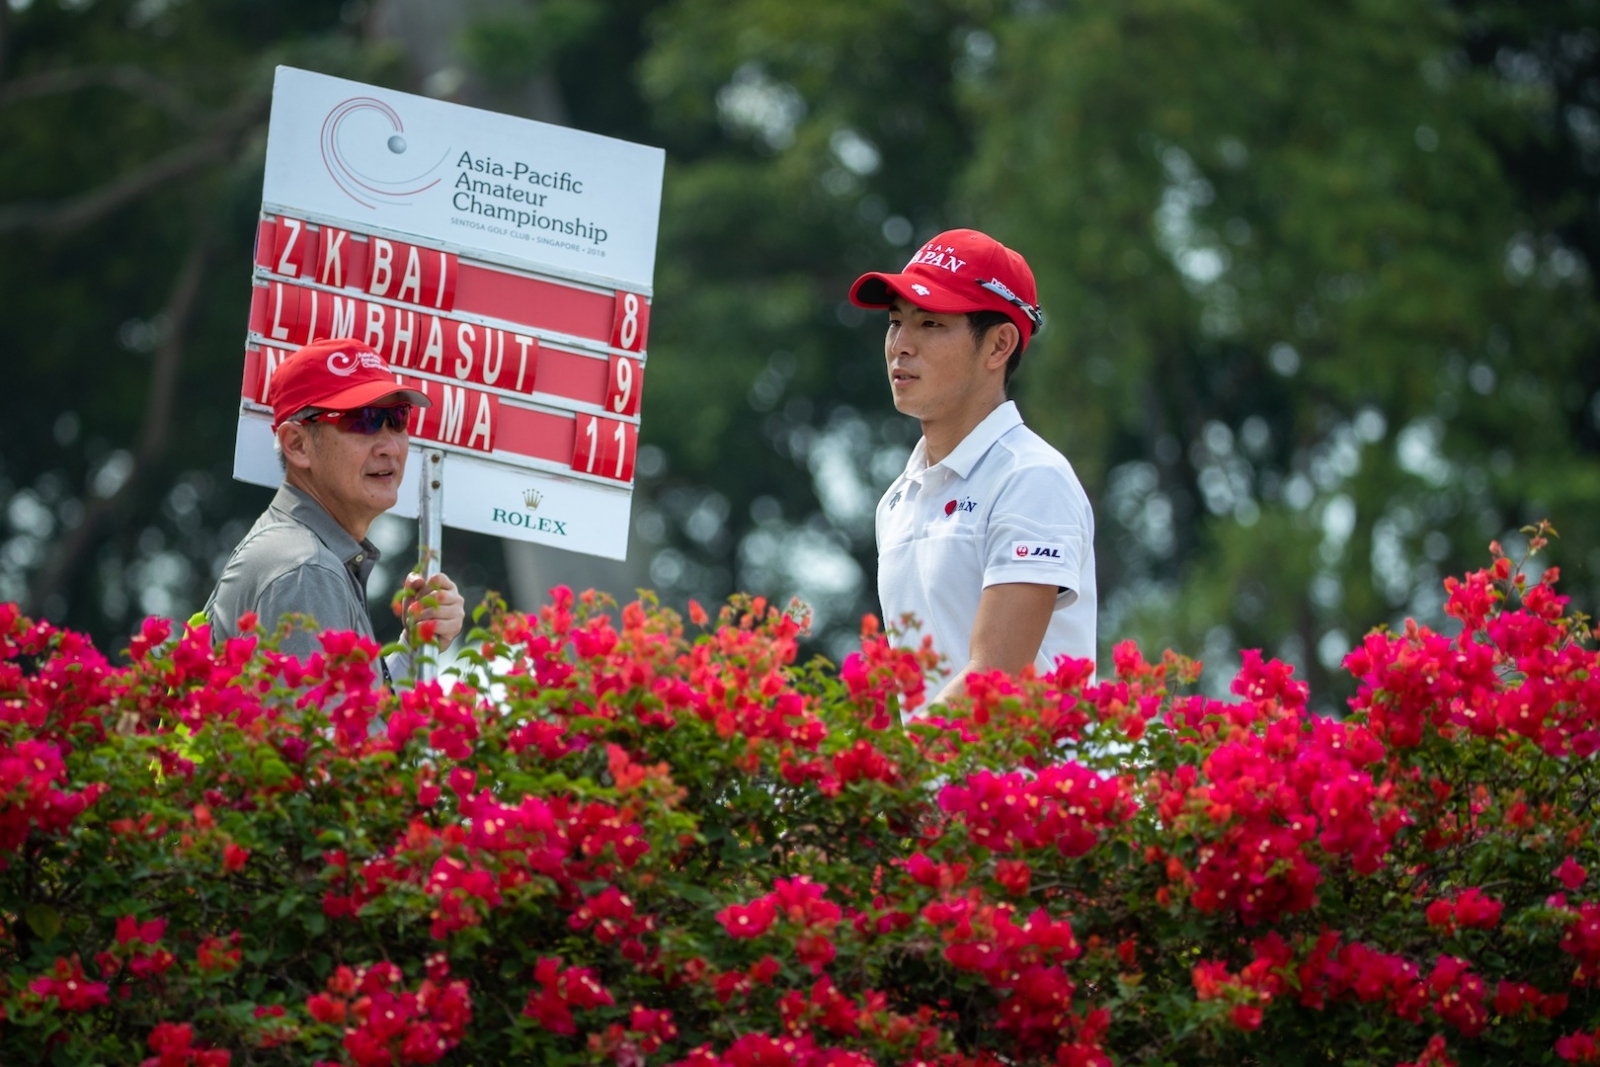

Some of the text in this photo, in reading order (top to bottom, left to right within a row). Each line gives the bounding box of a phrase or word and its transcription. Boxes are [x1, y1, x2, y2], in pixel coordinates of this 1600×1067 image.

[455, 171, 547, 207] Amateur
[456, 150, 583, 194] Asia-Pacific
[450, 217, 606, 257] SENTOSA GOLF CLUB SINGAPORE 2018
[453, 191, 608, 245] Championship
[903, 250, 966, 273] APAN
[277, 218, 638, 349] Z K BAI 8
[271, 283, 632, 413] LIMBHASUT 9
[586, 416, 625, 478] 11
[492, 508, 567, 536] ROLEX
[1030, 547, 1061, 558] JAL
